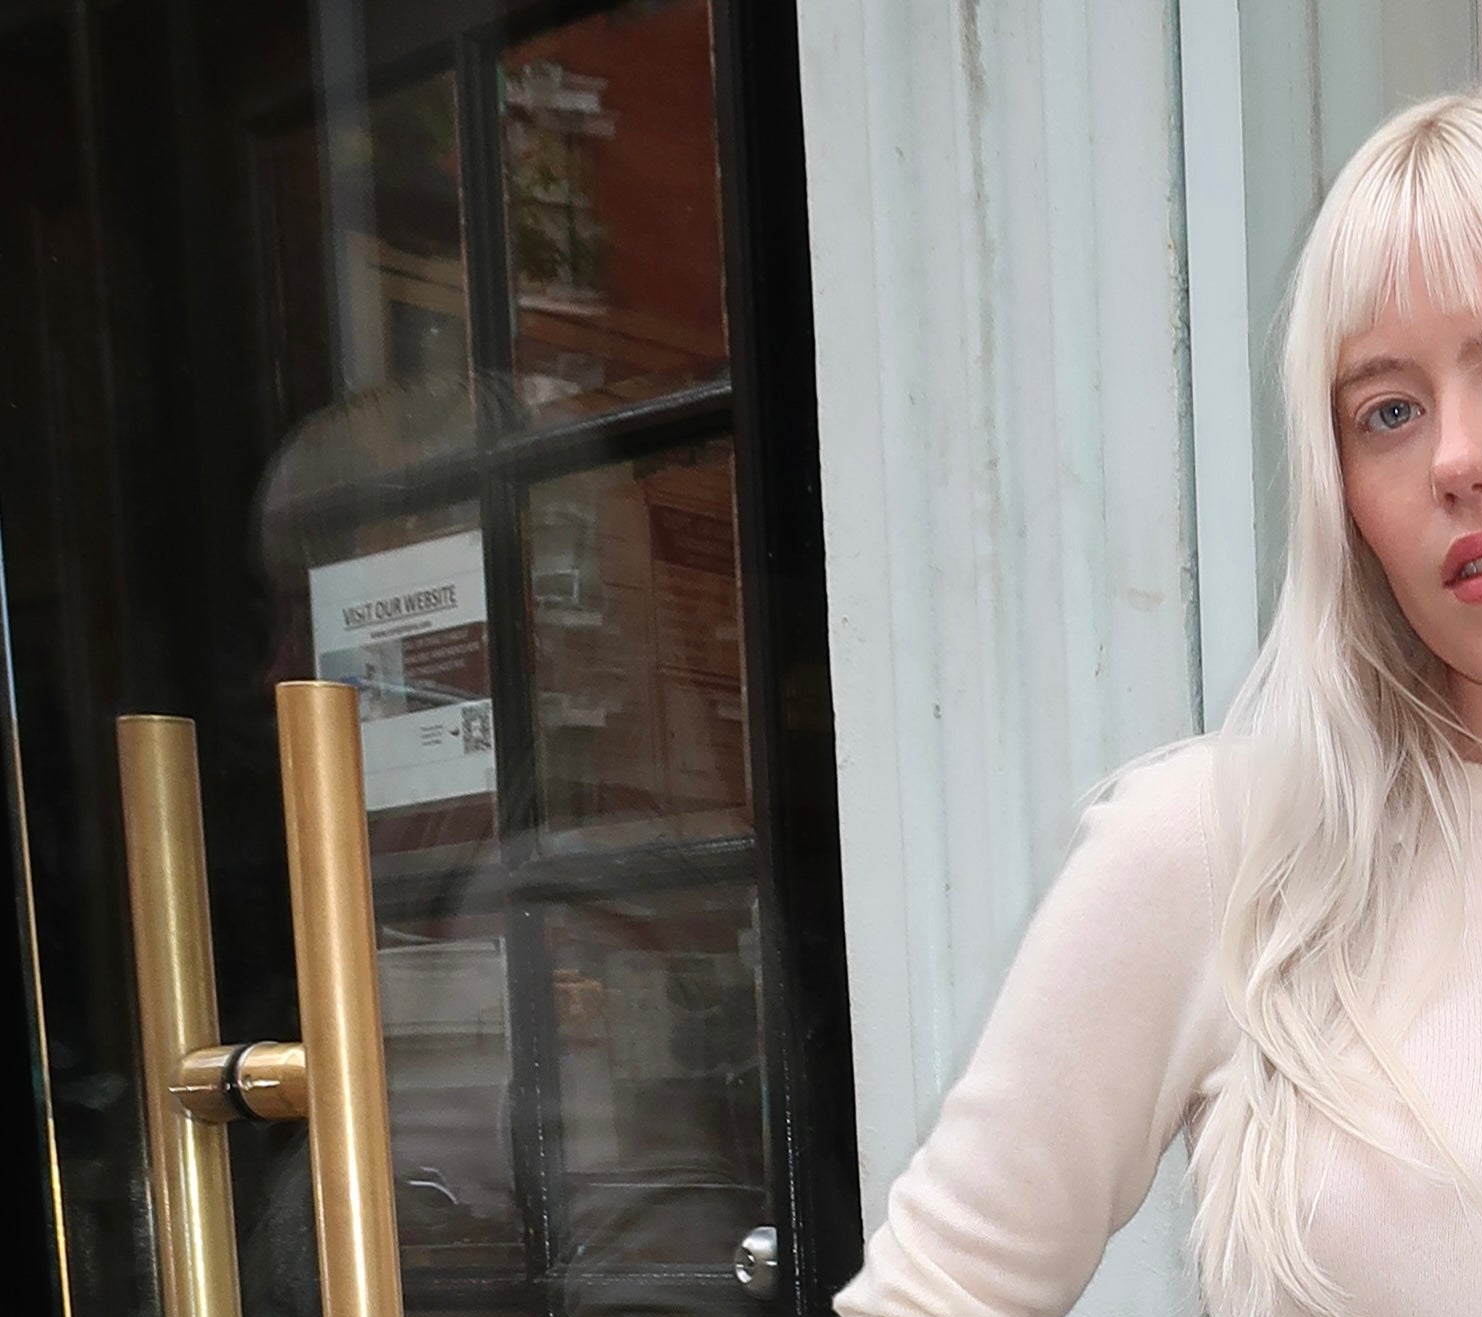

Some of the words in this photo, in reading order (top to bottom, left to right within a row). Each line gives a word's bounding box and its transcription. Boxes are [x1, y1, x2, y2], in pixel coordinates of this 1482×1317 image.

[342, 603, 373, 626] VISIT
[374, 596, 402, 619] OUR
[405, 583, 457, 612] WEBSITE
